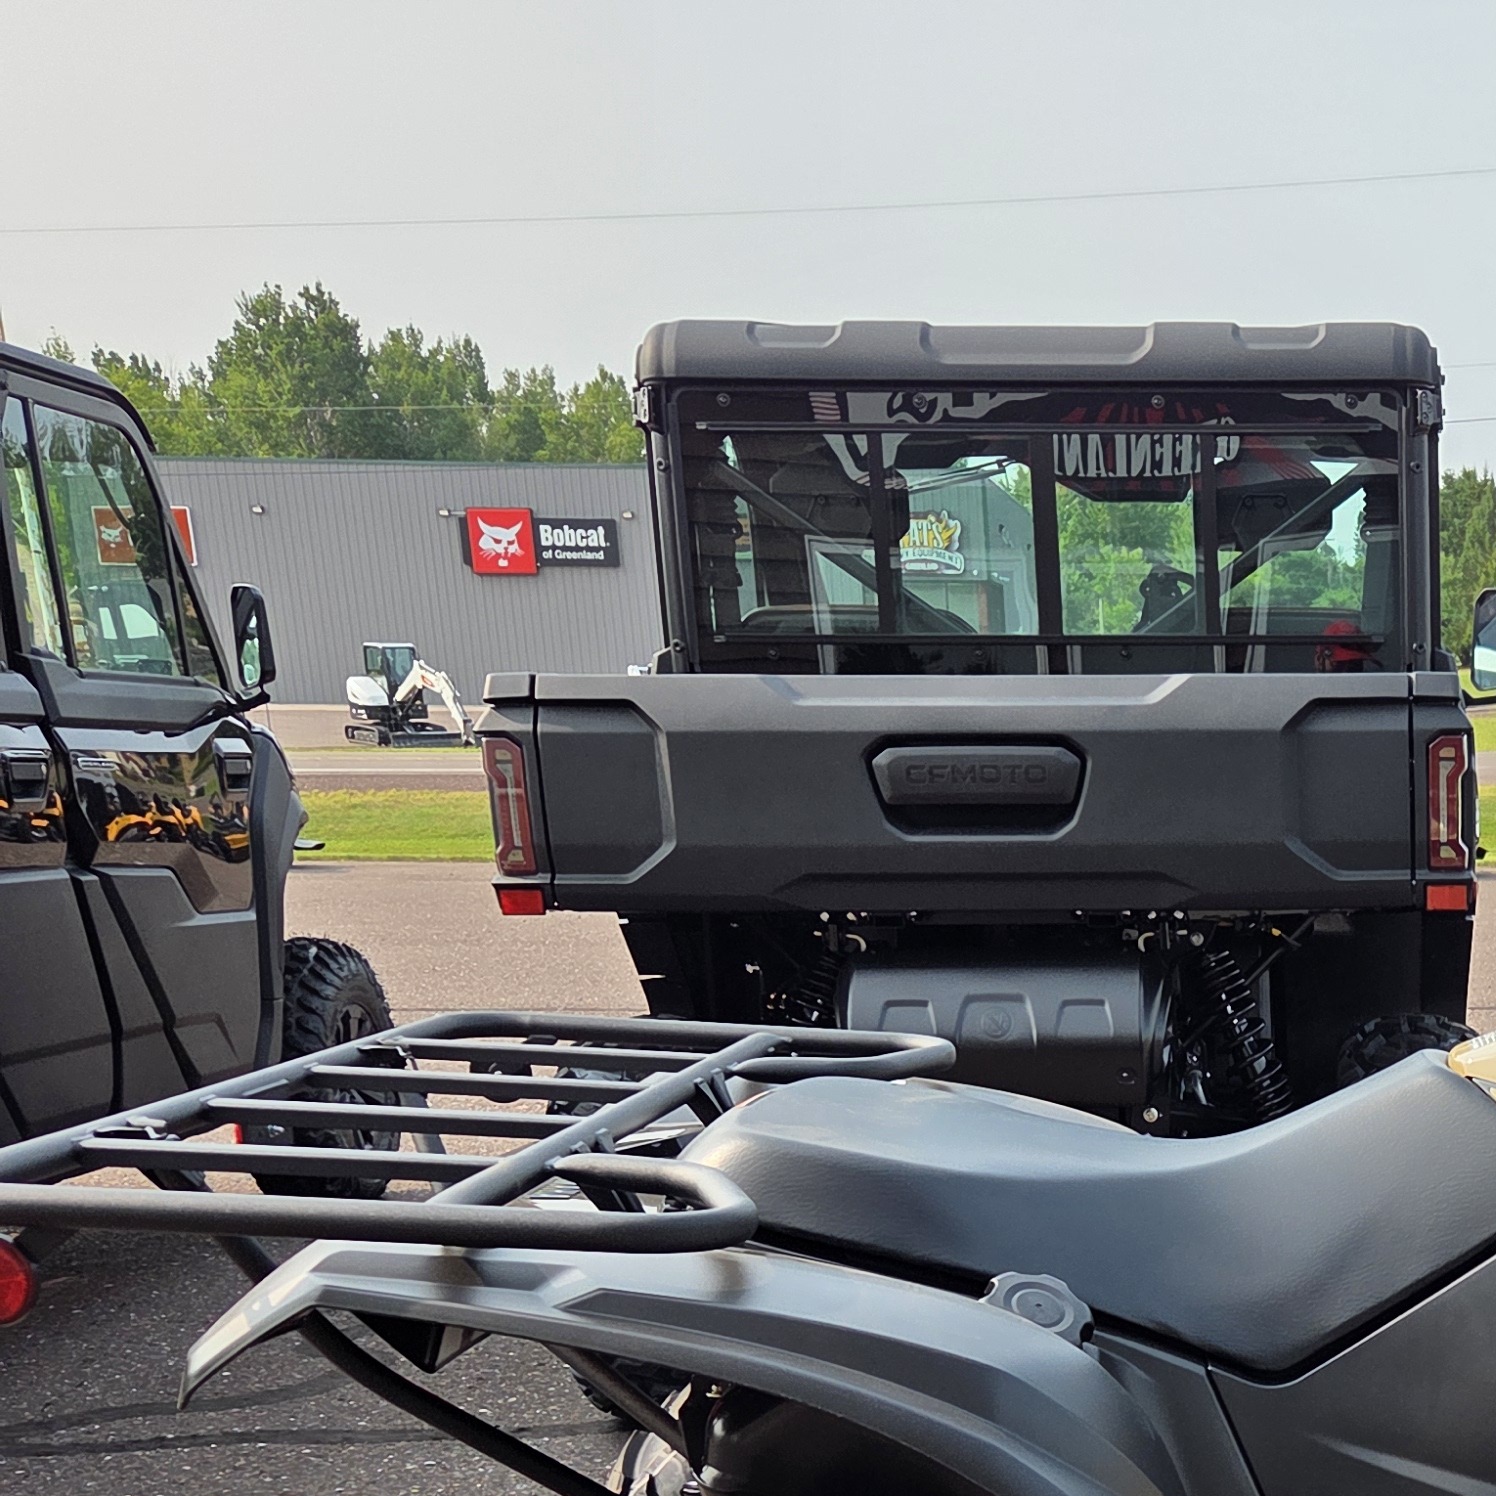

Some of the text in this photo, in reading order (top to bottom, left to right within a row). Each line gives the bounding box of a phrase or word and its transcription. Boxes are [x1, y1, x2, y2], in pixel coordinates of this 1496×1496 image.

[539, 524, 606, 547] Bobcat
[542, 549, 604, 560] of Greenland
[905, 764, 1047, 784] CFMOTO
